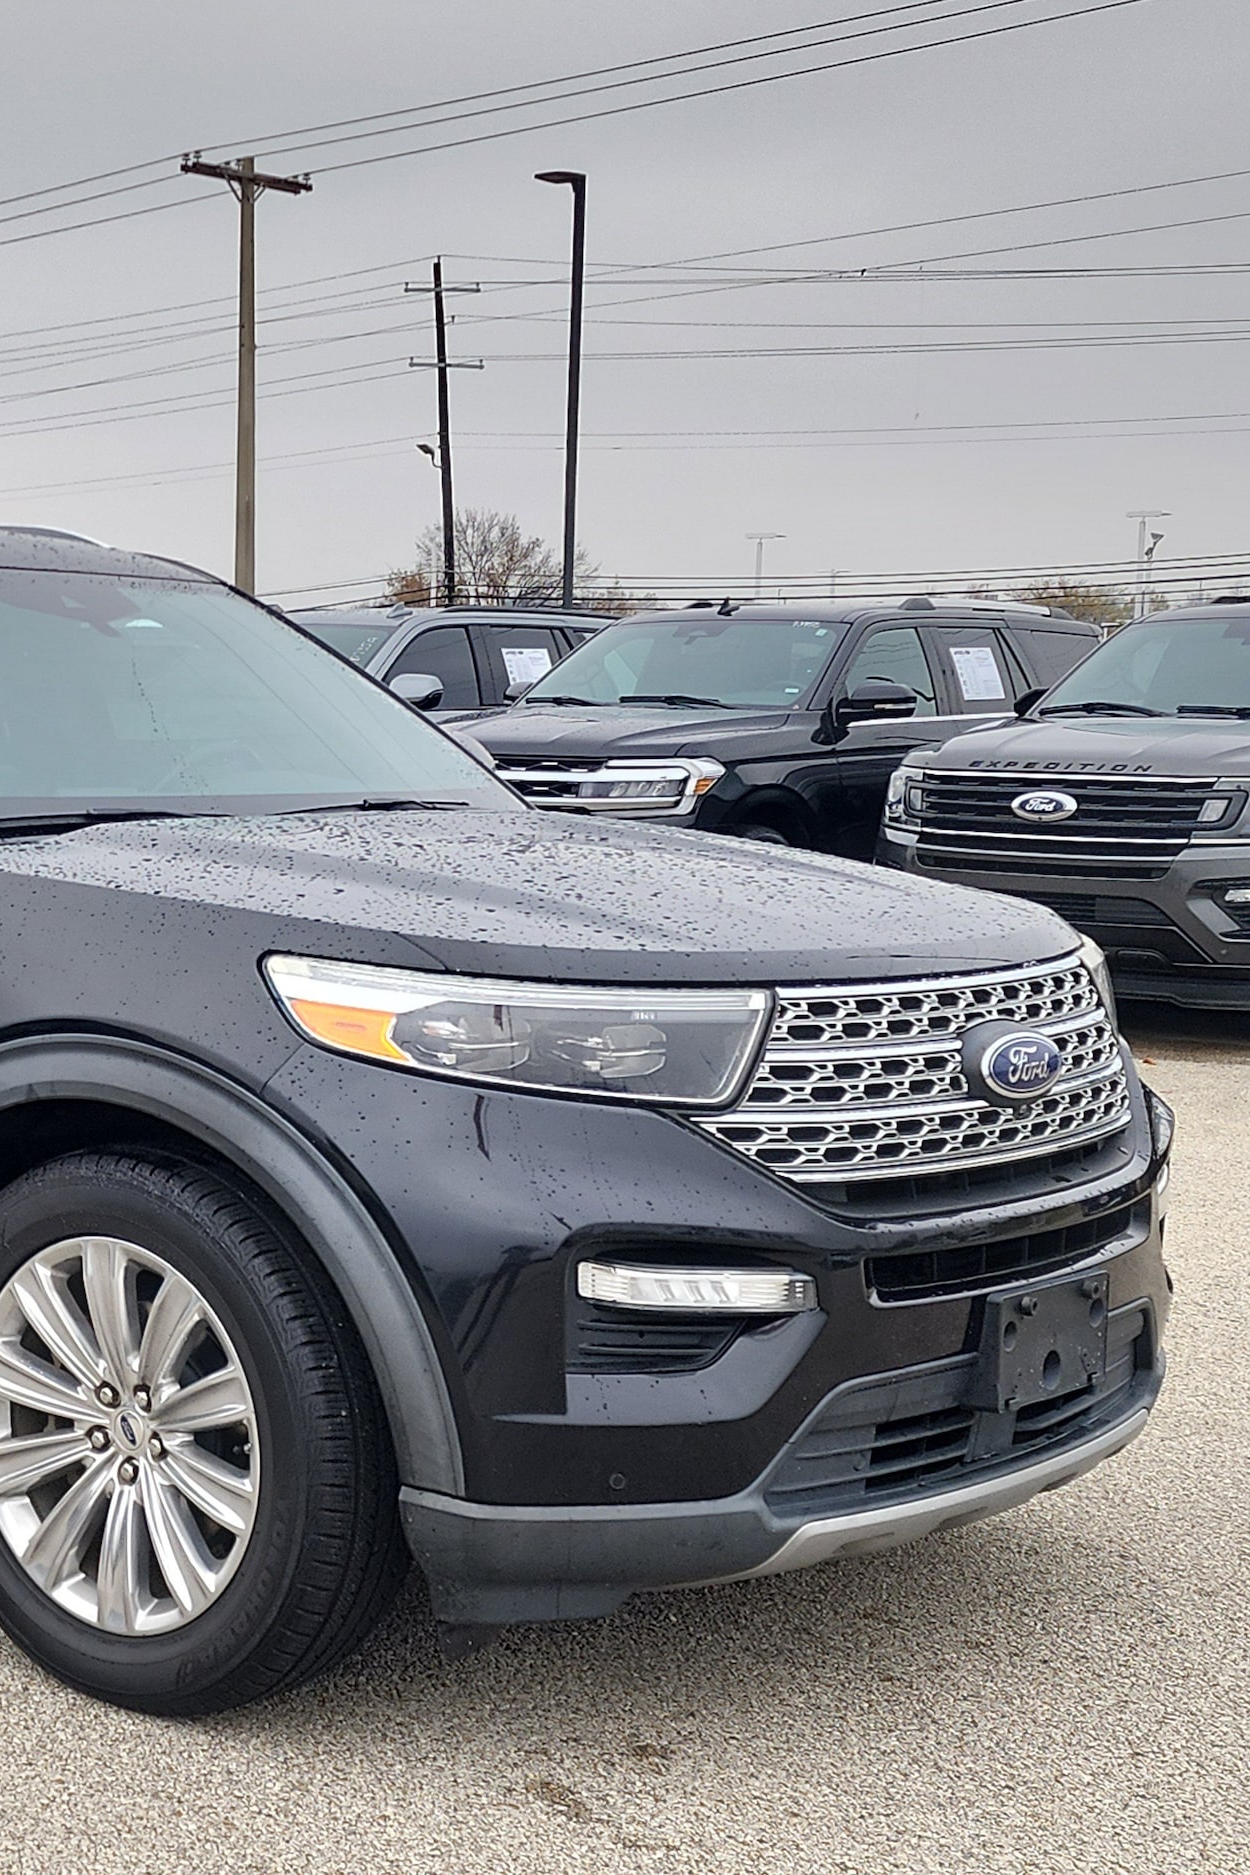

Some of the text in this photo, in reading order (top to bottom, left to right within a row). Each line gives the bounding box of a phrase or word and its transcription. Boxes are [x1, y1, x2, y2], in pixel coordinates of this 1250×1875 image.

[968, 760, 1153, 773] EXPEDITION
[1025, 797, 1056, 812] Ford
[1008, 1045, 1050, 1083] Ford
